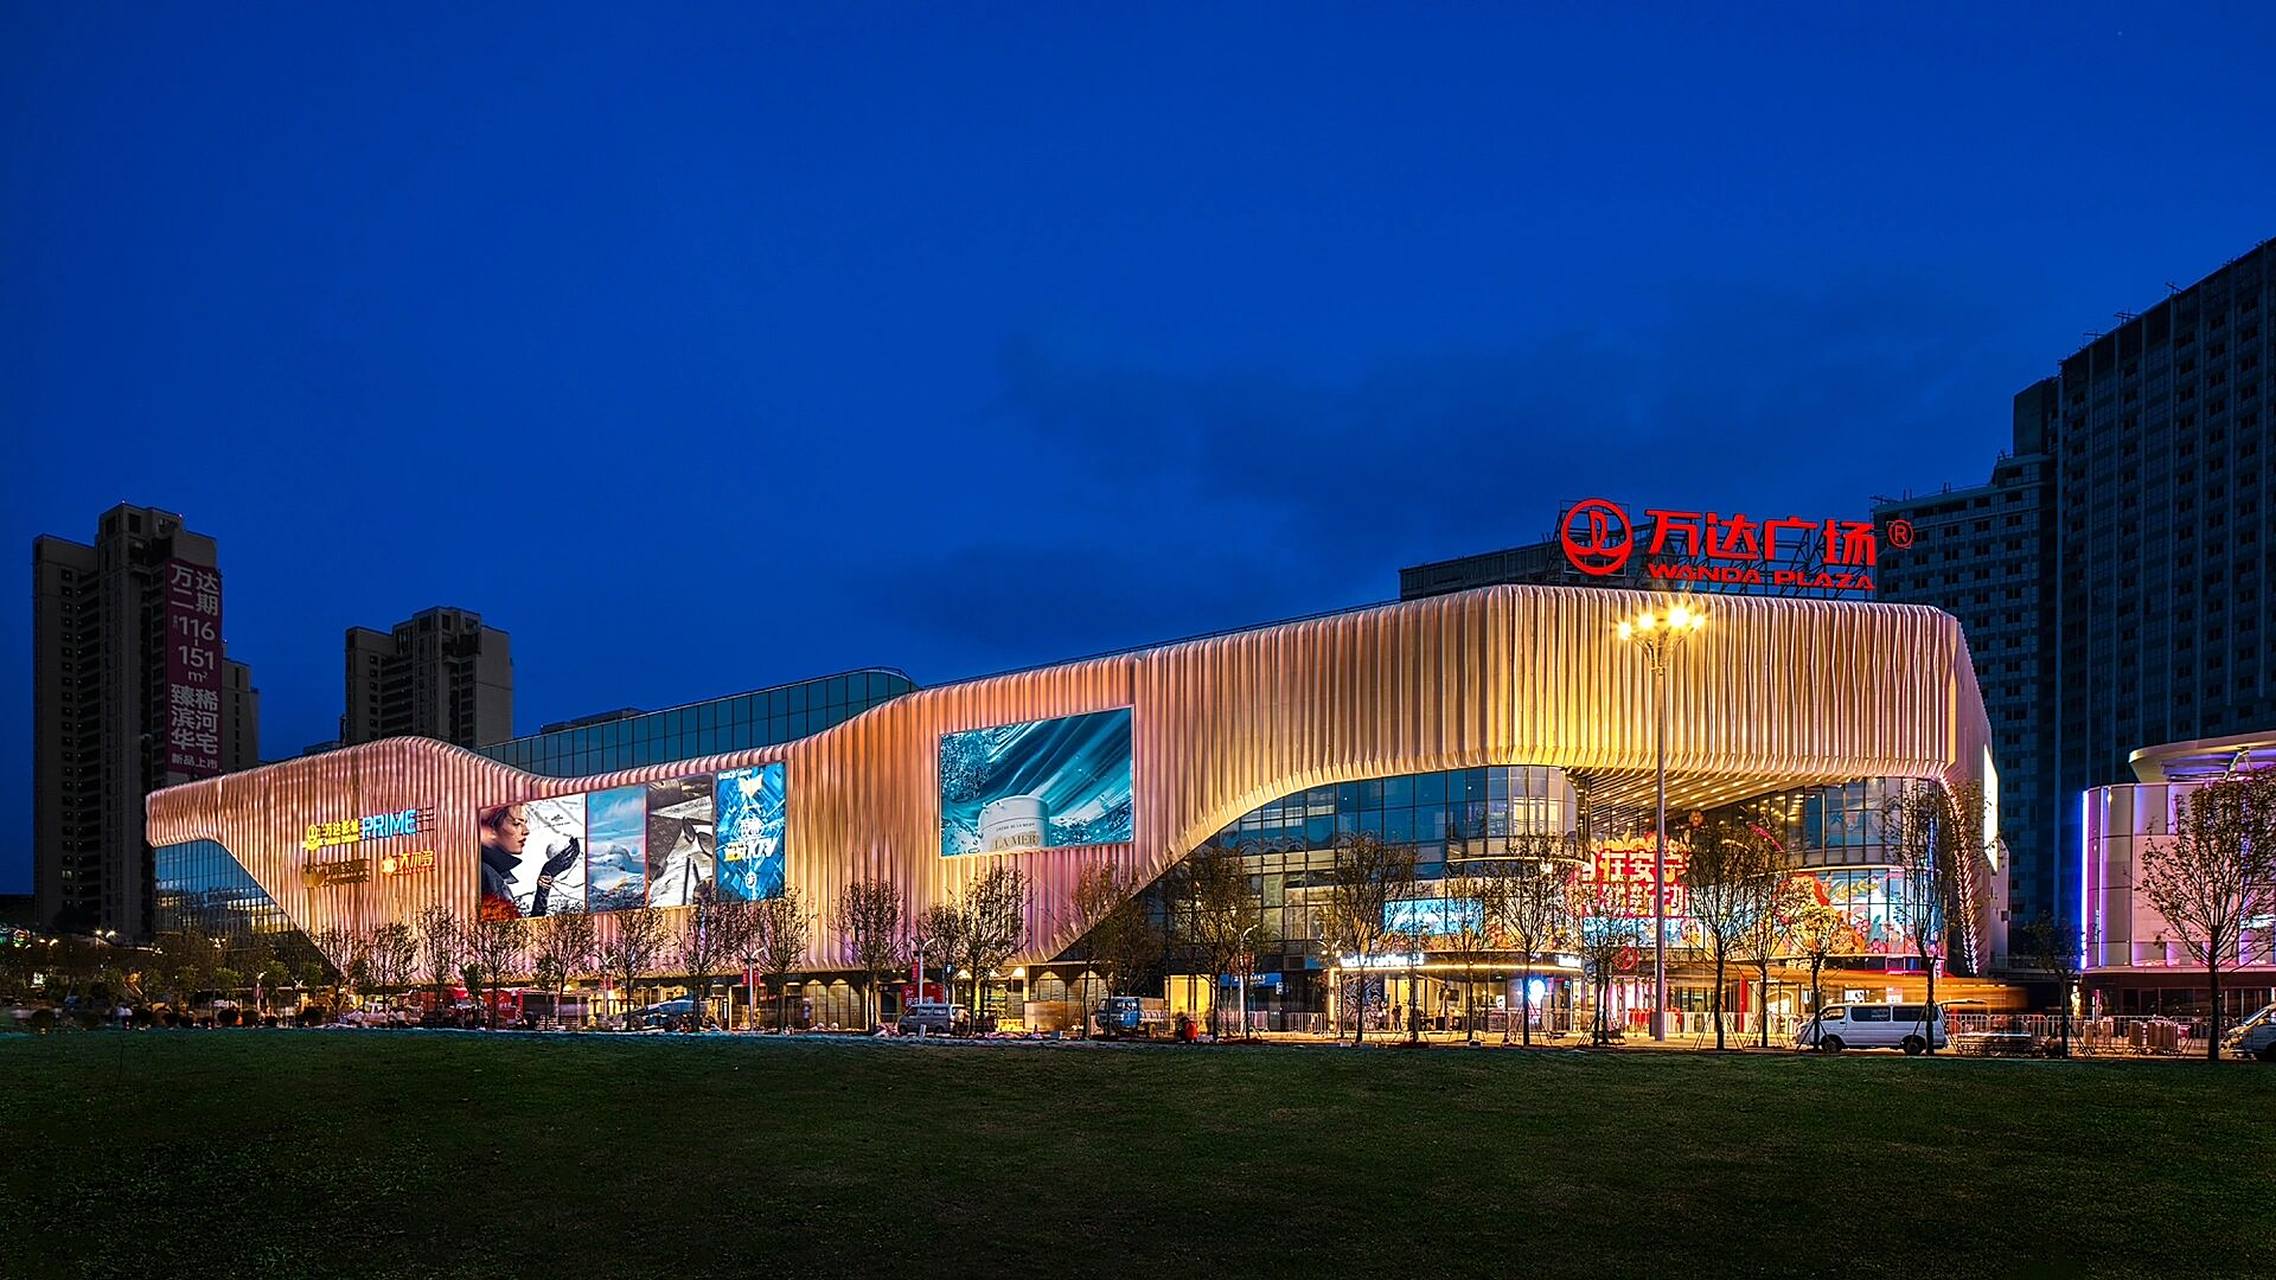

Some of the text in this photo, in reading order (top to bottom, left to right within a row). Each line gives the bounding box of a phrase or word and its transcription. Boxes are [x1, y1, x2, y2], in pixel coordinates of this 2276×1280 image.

[1645, 509, 1876, 567] 万达广场
[171, 564, 219, 596] 万达
[1647, 564, 1876, 590] WANDA PLAZA
[178, 615, 216, 641] 116
[178, 645, 214, 671] 151
[363, 809, 417, 840] PRIME
